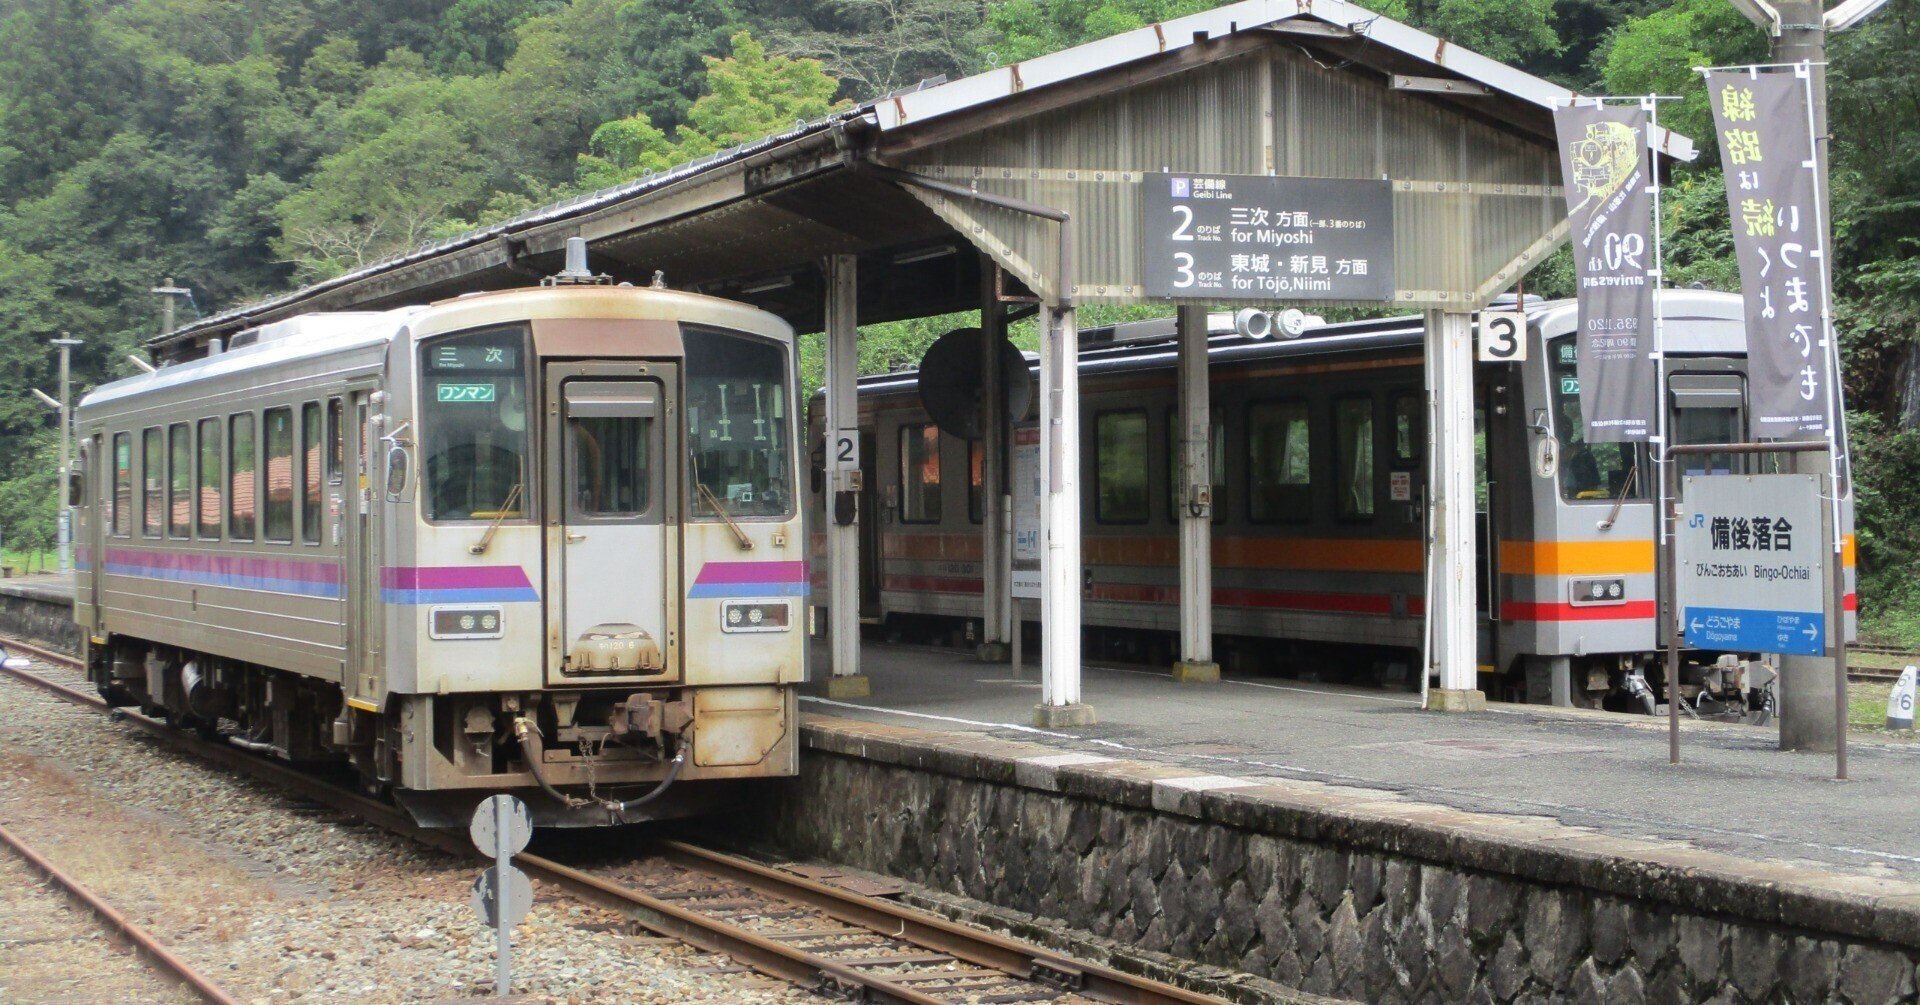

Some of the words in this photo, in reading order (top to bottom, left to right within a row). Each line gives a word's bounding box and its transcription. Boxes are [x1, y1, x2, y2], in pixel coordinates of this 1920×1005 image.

[1175, 180, 1185, 194] P
[1193, 178, 1226, 190] 芸備線
[1193, 191, 1214, 199] Geibi
[1215, 191, 1233, 199] Line
[1172, 205, 1194, 241] 2
[1230, 207, 1269, 226] 三次
[1276, 211, 1309, 228] 方面
[1197, 225, 1221, 234] のりば
[1231, 229, 1253, 243] for
[1257, 229, 1313, 247] Miyoshi
[1173, 252, 1195, 288] 3
[1231, 254, 1328, 273] 東城・新見
[1336, 259, 1368, 276] 方面
[1198, 271, 1222, 281] のりば
[1232, 276, 1253, 290] for
[1488, 317, 1518, 358] 3
[440, 386, 492, 399] ワンマン
[838, 438, 853, 462] 2
[1689, 513, 1705, 529] JR
[1710, 516, 1793, 552] 備後落合
[1696, 563, 1747, 578] びんごおちあい
[1754, 564, 1810, 582] Bingo-Ochiai
[1706, 615, 1741, 630] どうごやま
[1900, 693, 1912, 710] 6
